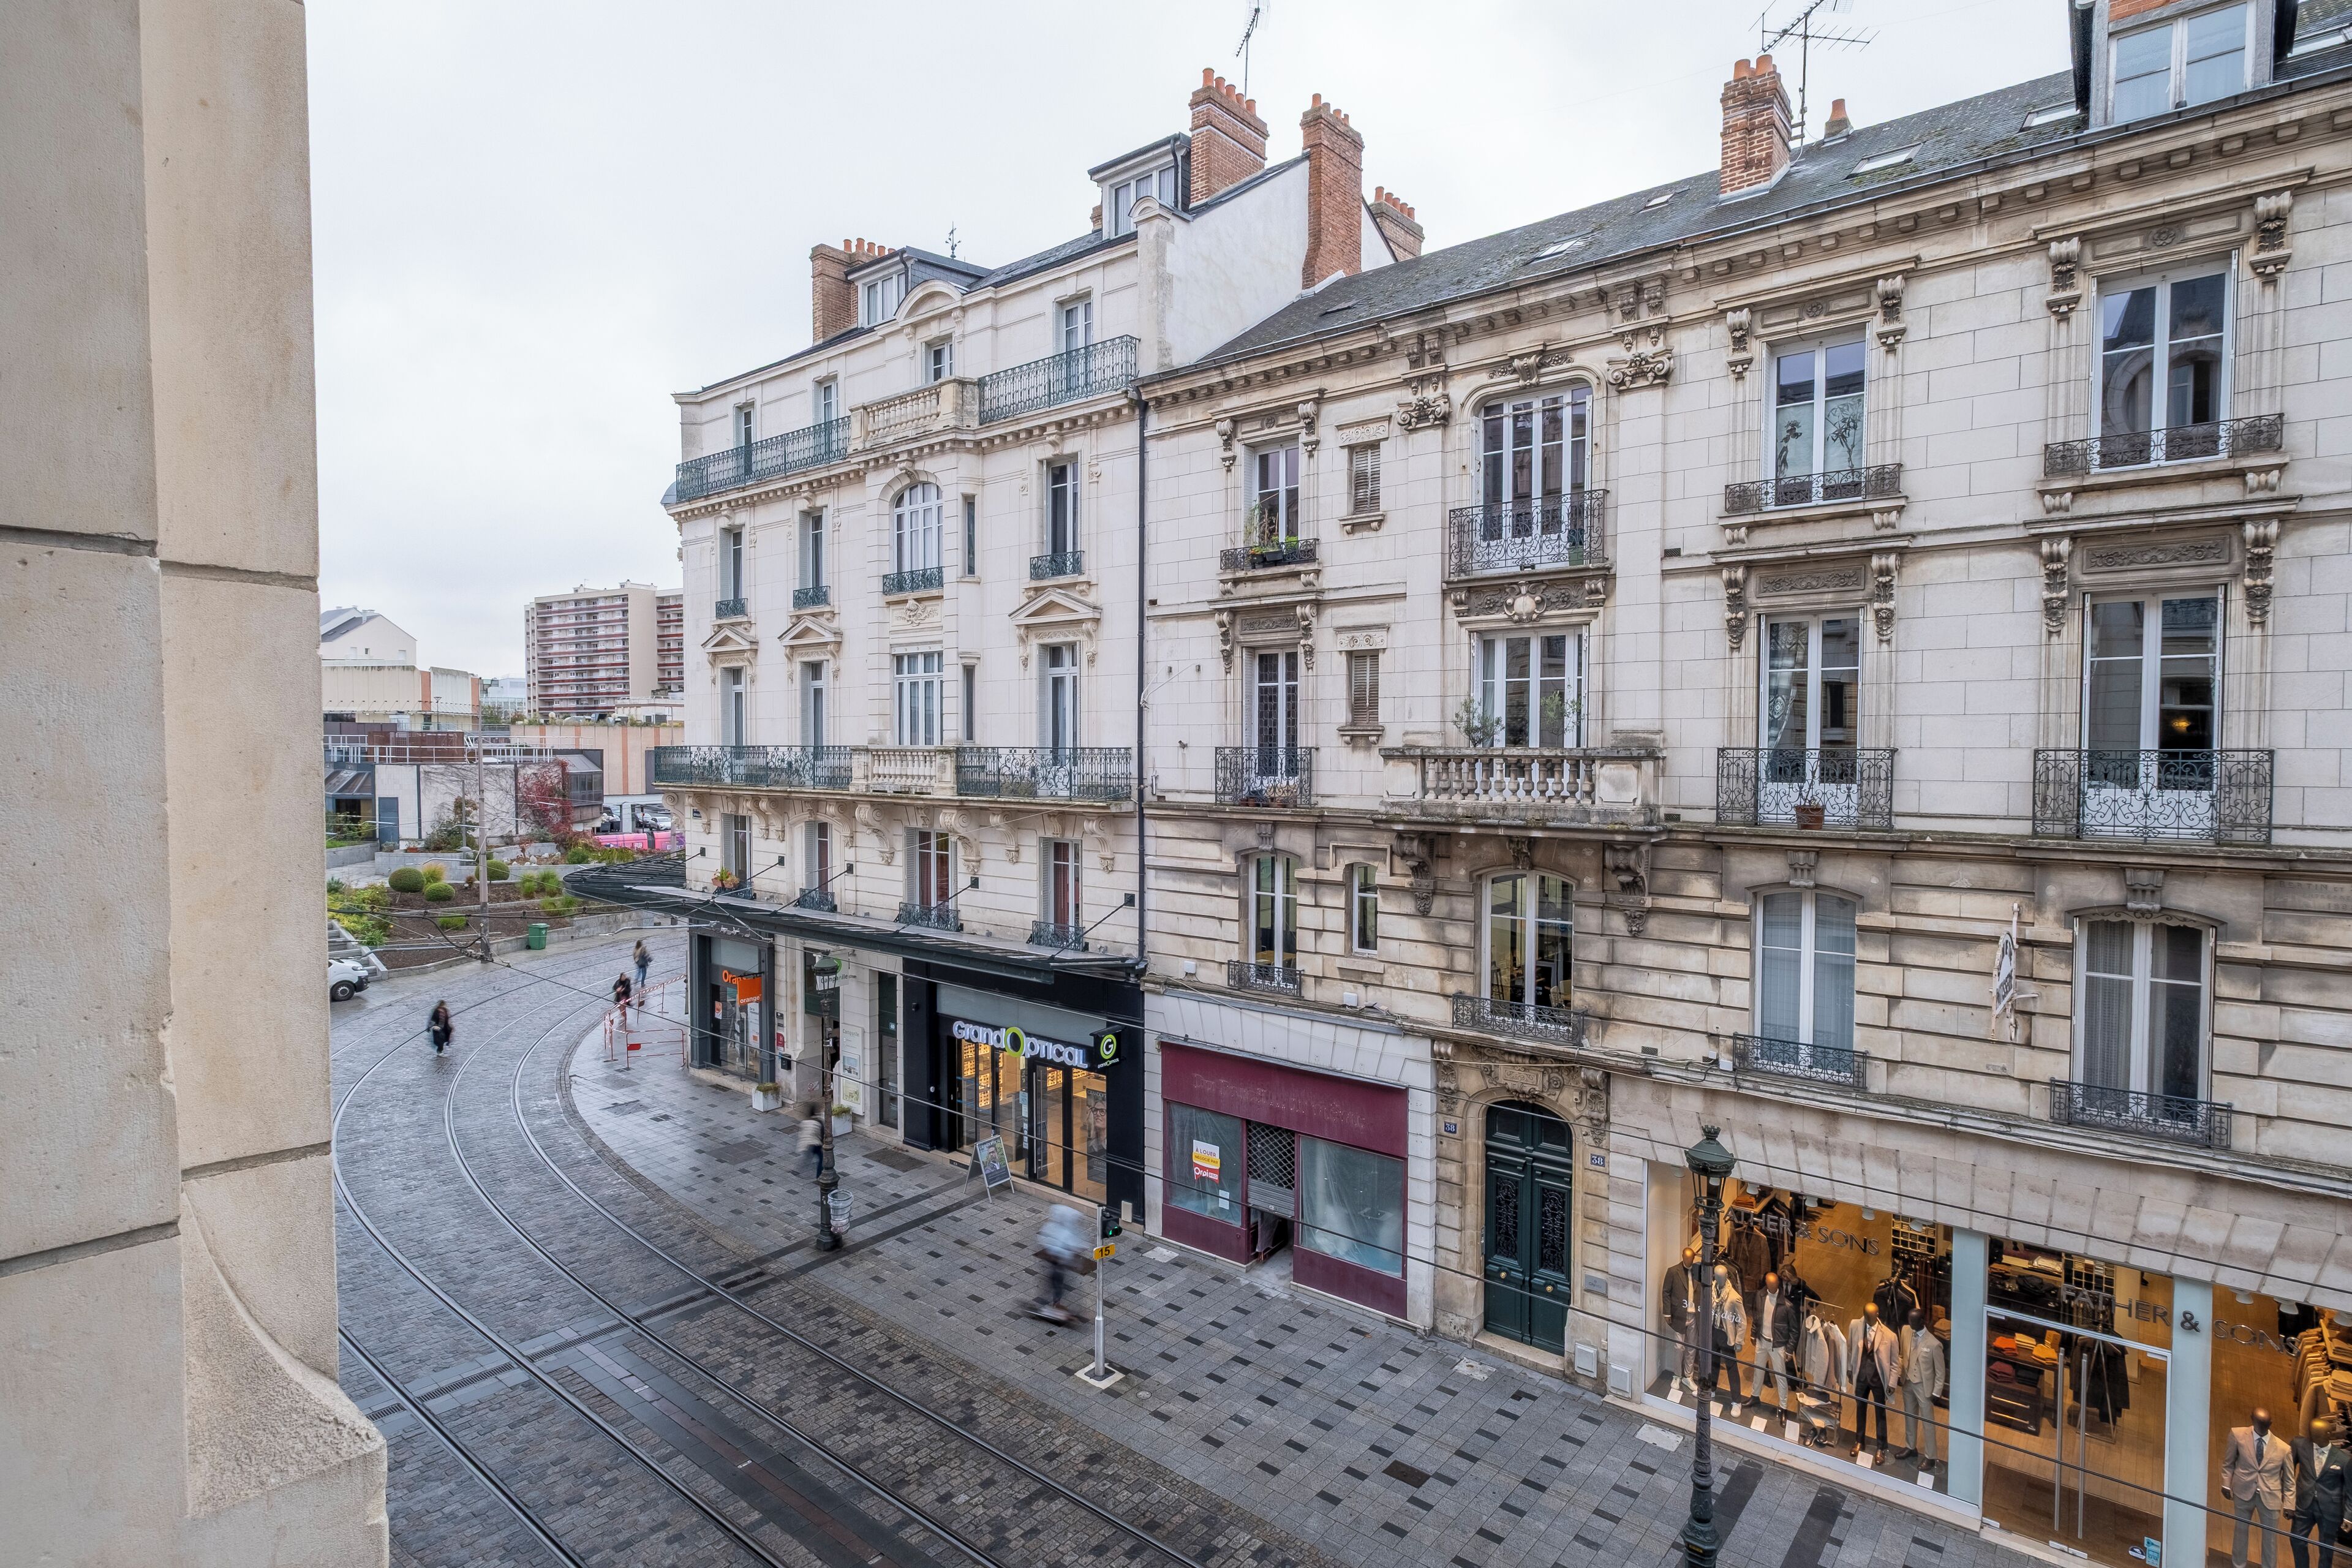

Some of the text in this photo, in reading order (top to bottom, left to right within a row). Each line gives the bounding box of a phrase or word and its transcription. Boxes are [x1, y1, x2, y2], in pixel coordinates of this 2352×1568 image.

[1445, 1123, 1455, 1132] 38
[1200, 1148, 1216, 1158] LOUER
[1592, 1155, 1604, 1165] 38
[1194, 1166, 1209, 1178] Orpi
[1720, 1205, 1880, 1256] ATHER & SONS
[1098, 1246, 1110, 1257] 15
[2060, 1283, 2302, 1358] FATHER & SONS
